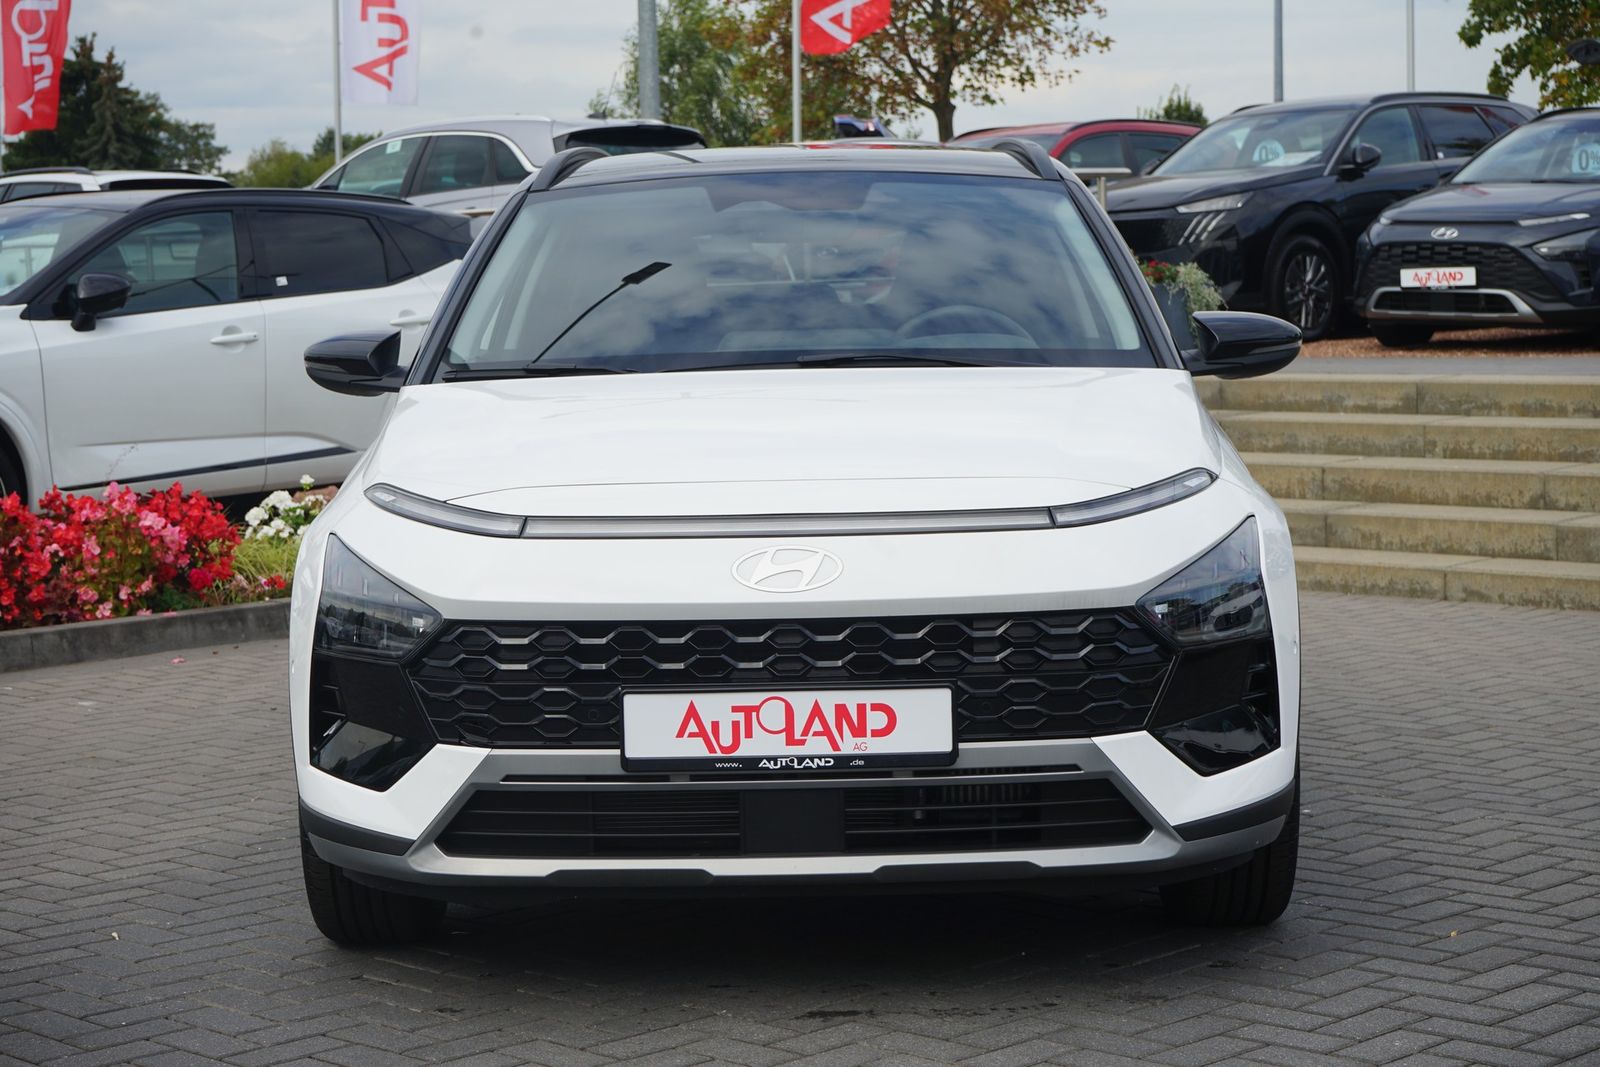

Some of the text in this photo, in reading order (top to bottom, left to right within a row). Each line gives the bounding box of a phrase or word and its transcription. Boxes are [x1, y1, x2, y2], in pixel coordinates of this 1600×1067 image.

[675, 696, 897, 755] AUTOLAND
[853, 742, 868, 752] AG
[758, 757, 834, 769] AUTOLAND
